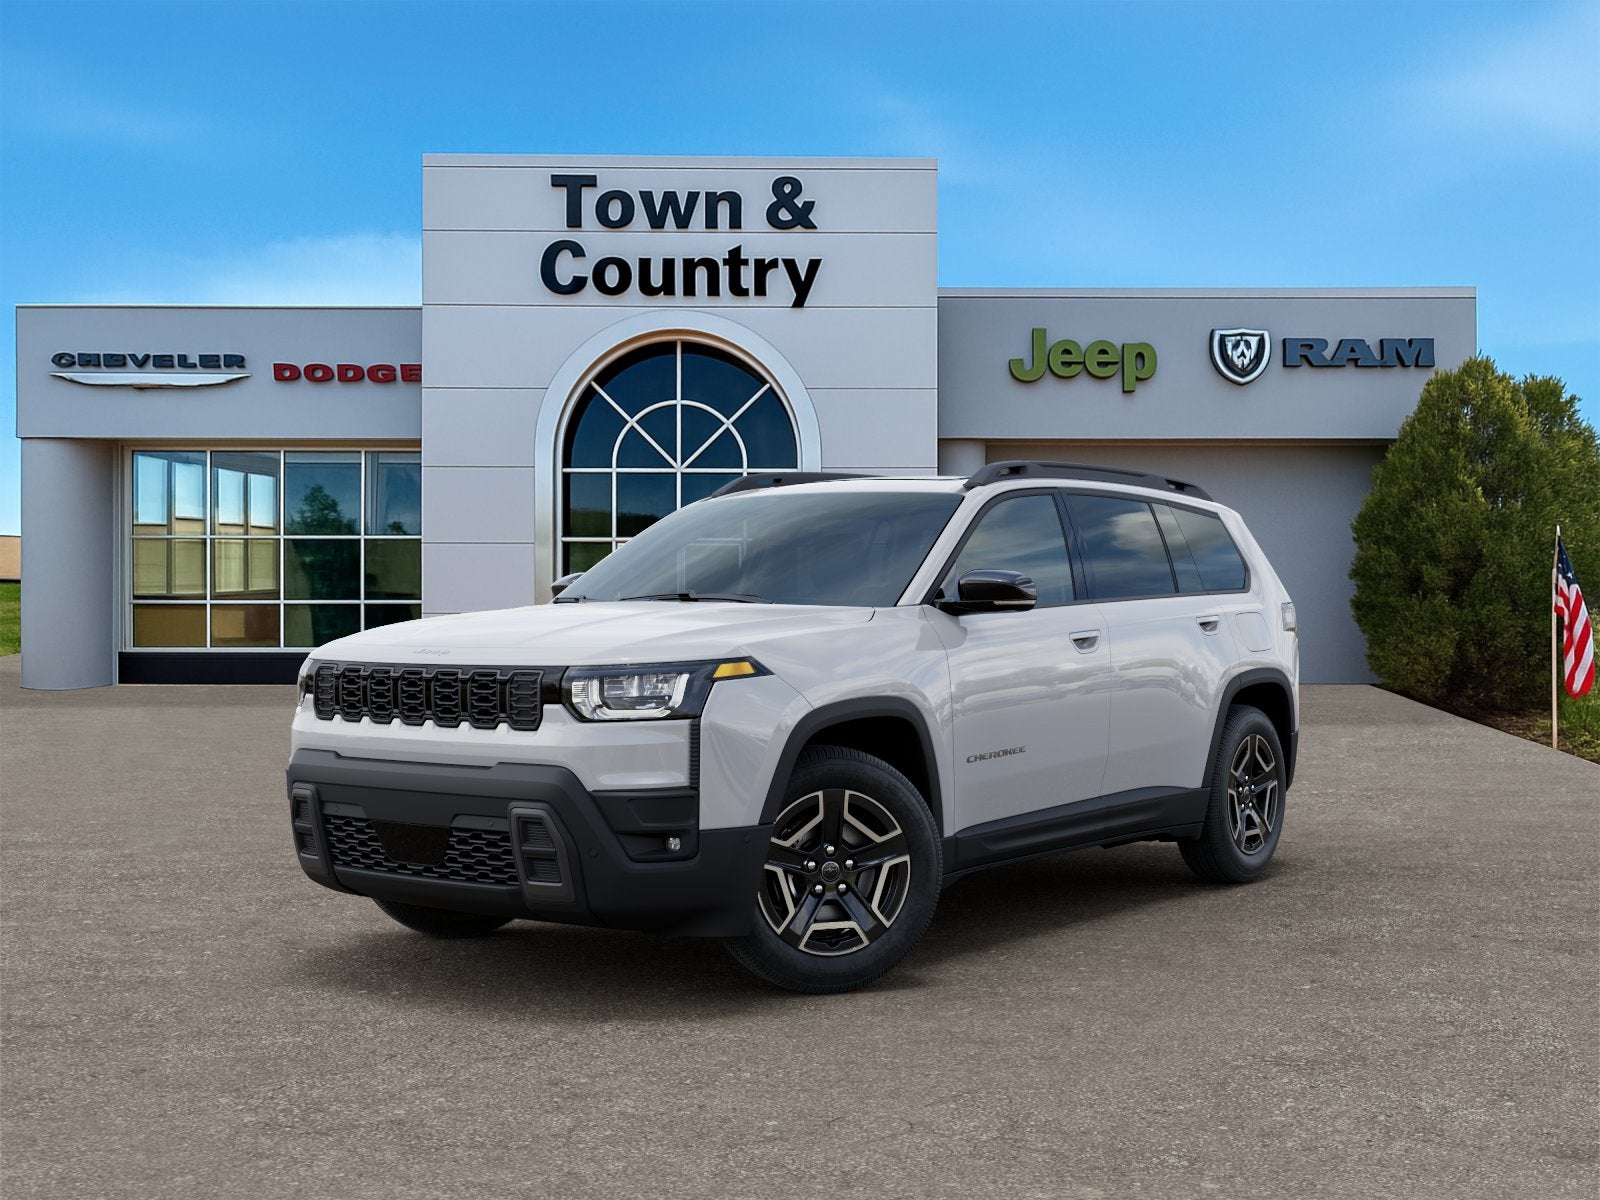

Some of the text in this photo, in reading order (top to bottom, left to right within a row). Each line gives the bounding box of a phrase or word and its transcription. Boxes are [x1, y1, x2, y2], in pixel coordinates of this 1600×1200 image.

[550, 174, 818, 230] Town &
[540, 239, 822, 308] Country
[273, 362, 422, 383] DODGE
[1009, 328, 1158, 393] Jeep
[1283, 337, 1435, 367] RAM
[966, 745, 1027, 764] CHEROKEE
